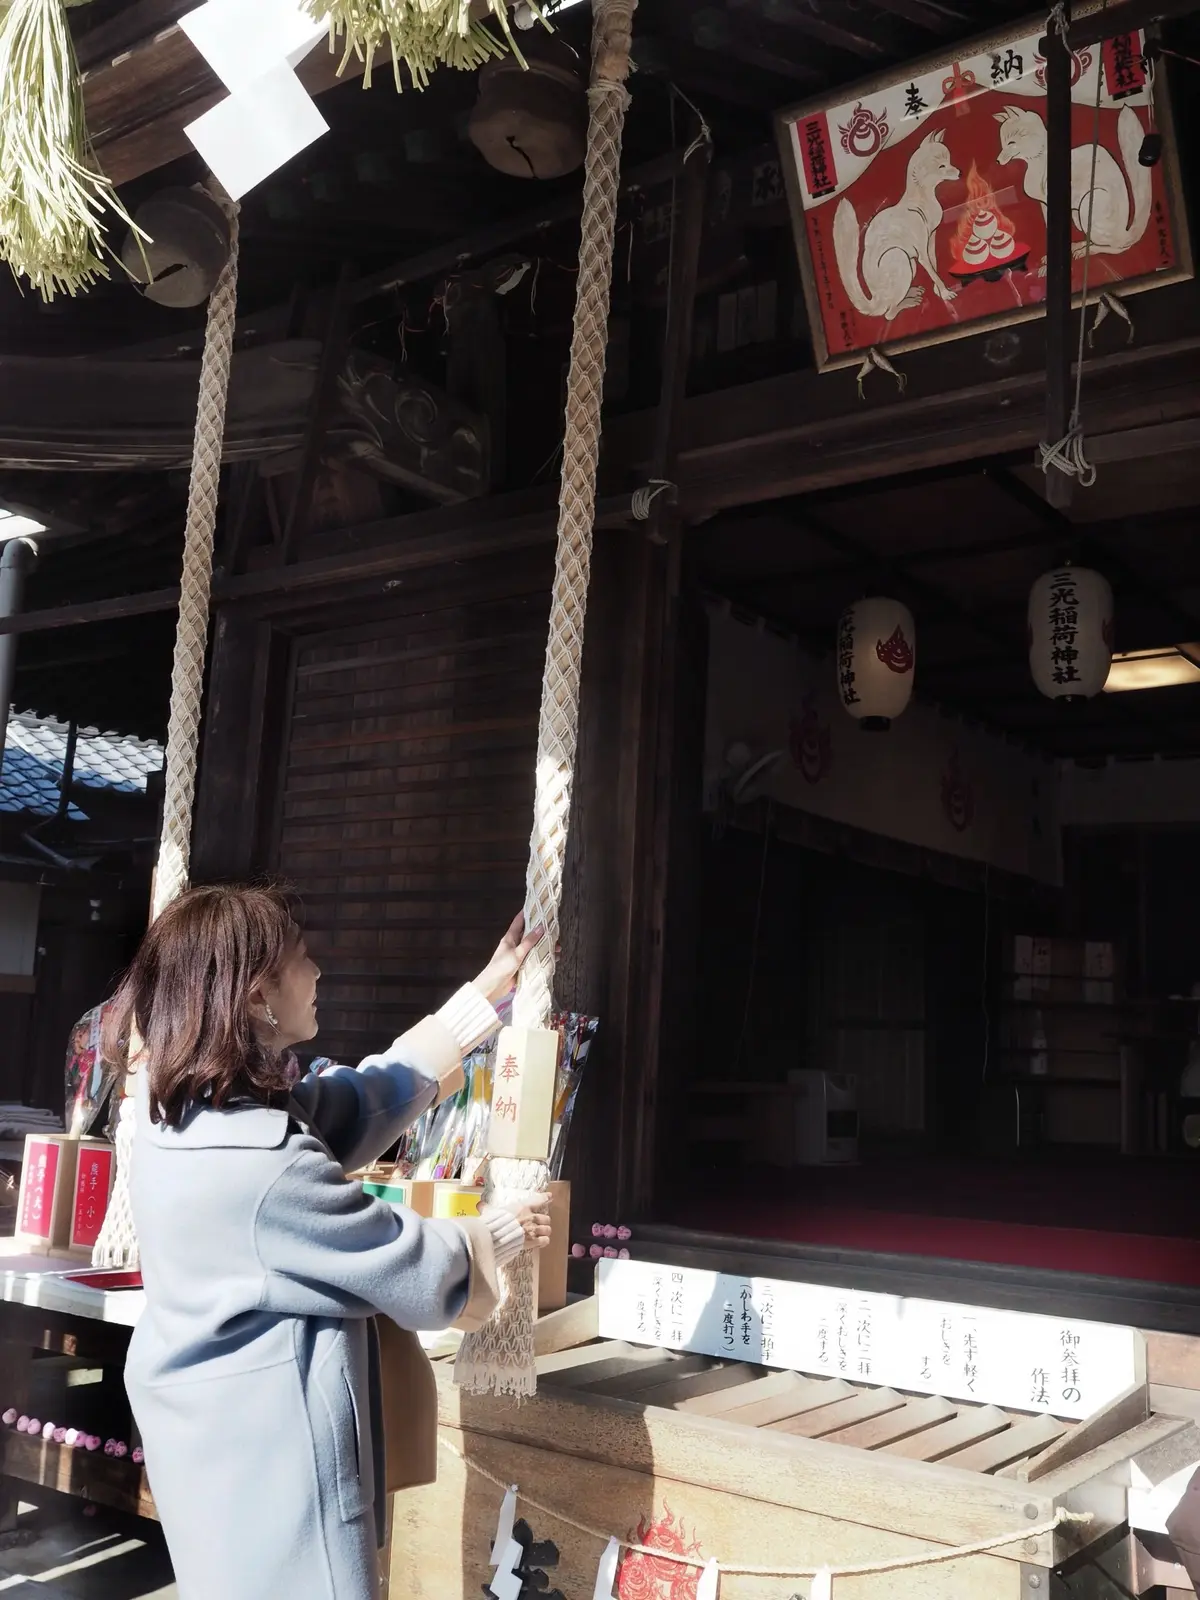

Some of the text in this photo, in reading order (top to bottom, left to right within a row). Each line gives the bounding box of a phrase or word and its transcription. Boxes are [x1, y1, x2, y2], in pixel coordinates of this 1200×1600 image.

[904, 49, 1024, 120] 奉 納
[1048, 573, 1082, 685] 三光稲荷神社
[495, 1054, 520, 1123] 奉納
[671, 1272, 684, 1342] 四、次に一拝
[721, 1303, 735, 1352] 二度打つ）
[739, 1284, 752, 1345] （かしわ手を
[1031, 1367, 1050, 1405] 作法
[1060, 1329, 1081, 1403] 御参拝の
